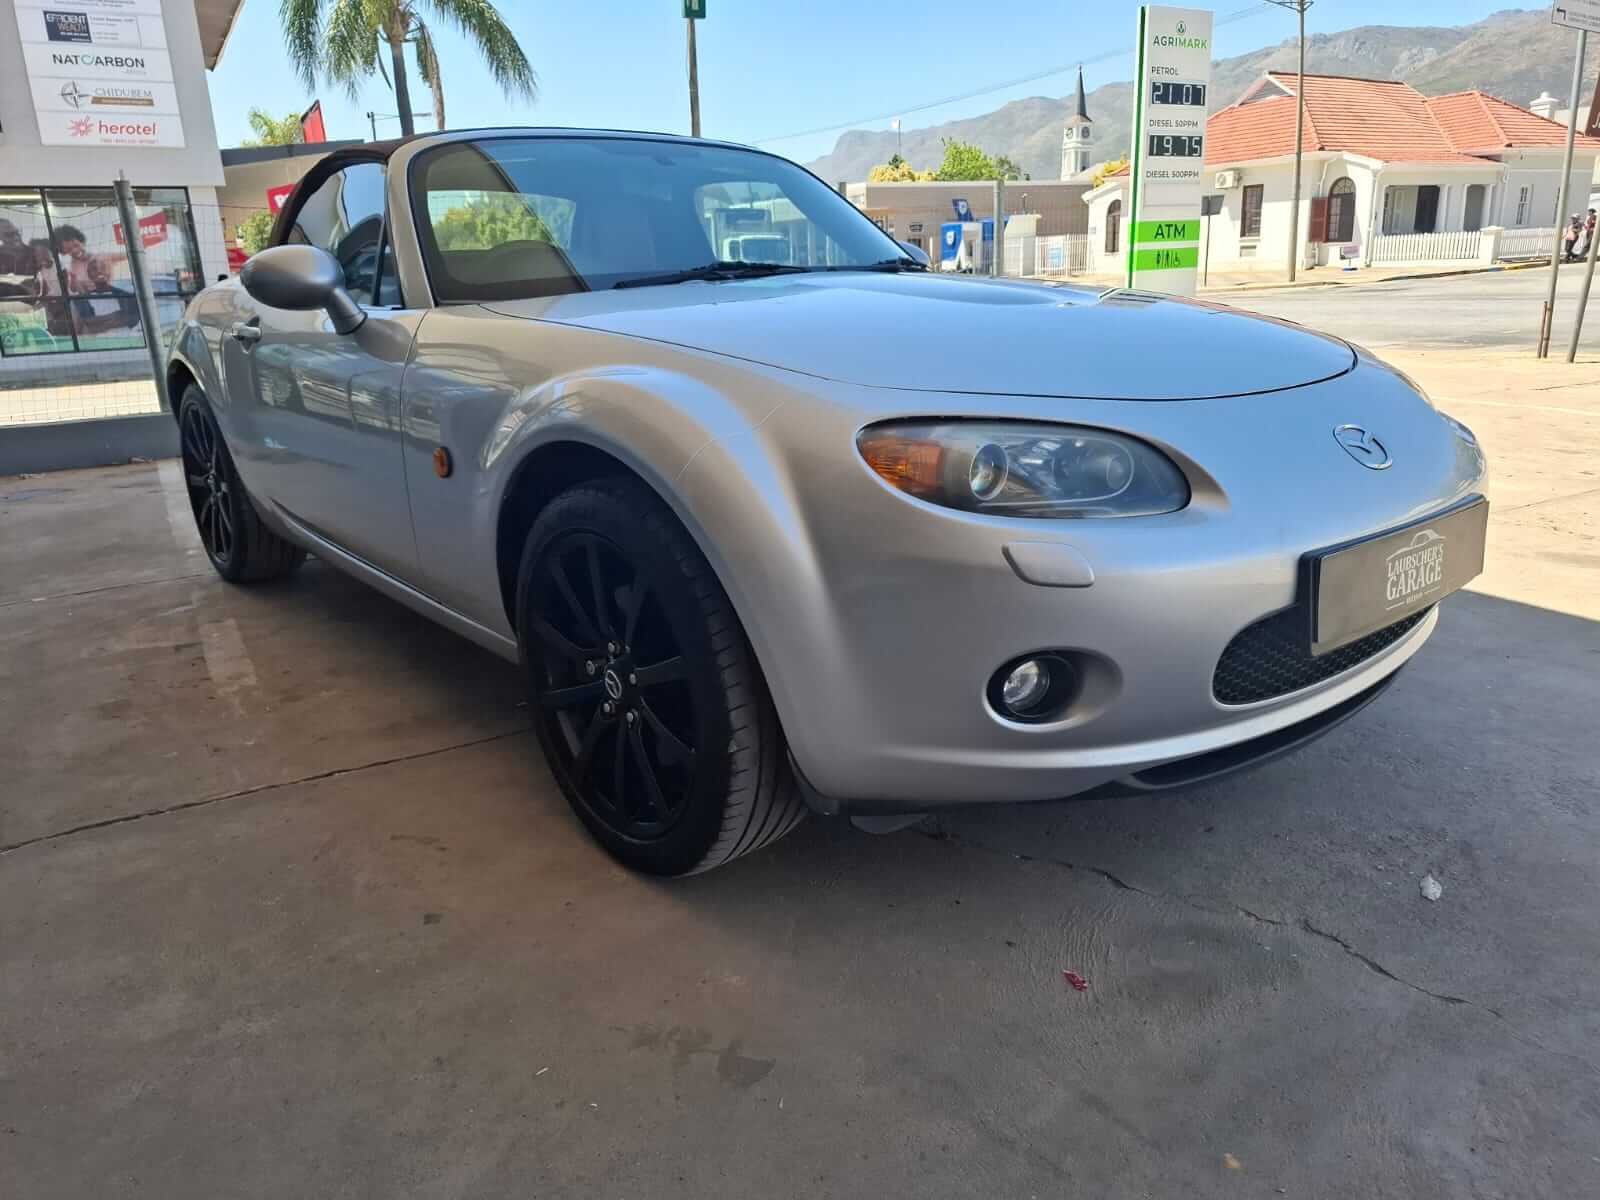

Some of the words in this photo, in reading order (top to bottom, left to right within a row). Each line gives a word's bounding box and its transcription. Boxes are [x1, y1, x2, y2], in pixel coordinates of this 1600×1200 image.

[1153, 35, 1208, 48] AGRIMARK
[1151, 66, 1179, 76] PETROL
[98, 120, 156, 135] herotel
[1146, 170, 1170, 178] DIESEL
[1172, 170, 1199, 178] 500PPM
[1153, 223, 1186, 240] ATM
[1386, 560, 1442, 600] GARAGE
